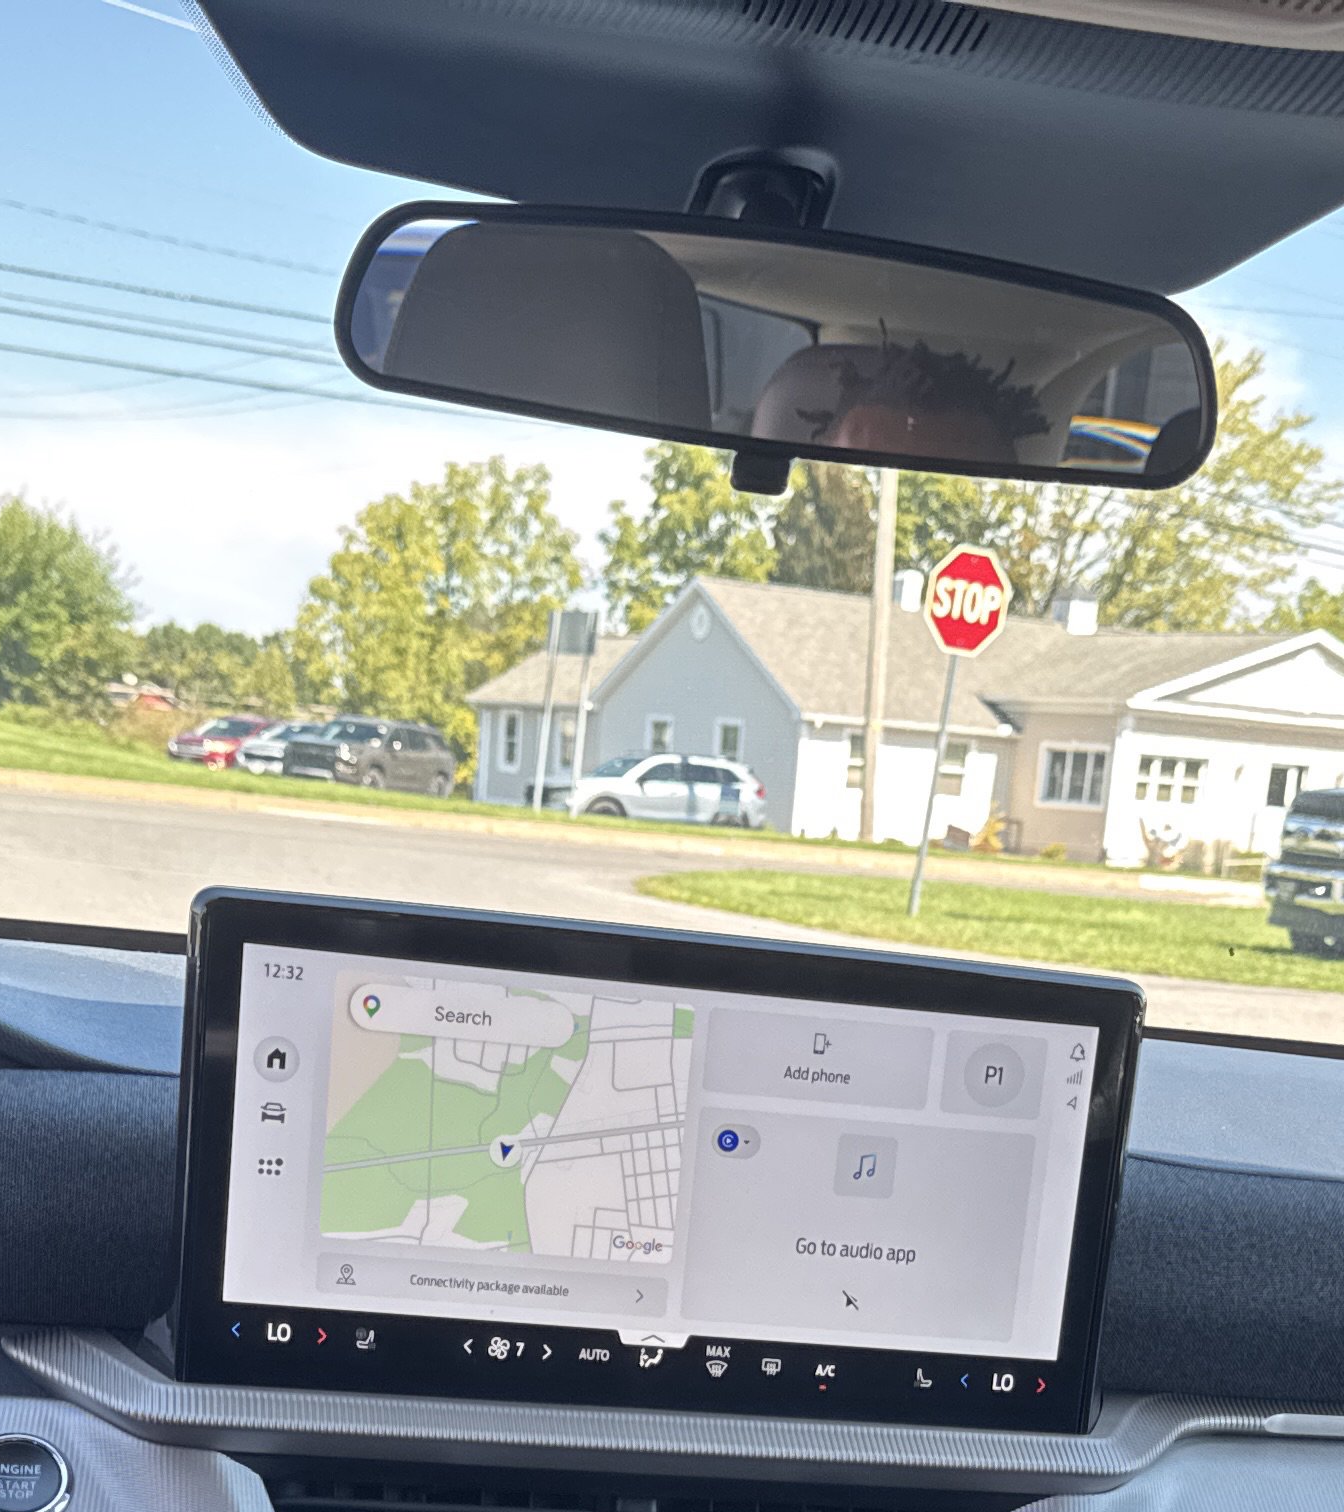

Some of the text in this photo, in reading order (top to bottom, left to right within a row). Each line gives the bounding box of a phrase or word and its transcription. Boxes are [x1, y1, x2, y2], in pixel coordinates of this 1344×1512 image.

[932, 576, 1002, 626] STOP
[264, 963, 304, 981] 12:32
[434, 1005, 492, 1027] Search
[783, 1065, 851, 1085] Add phone
[984, 1064, 1004, 1086] P1
[612, 1234, 663, 1254] Google
[795, 1237, 916, 1265] Go to audio app
[409, 1273, 570, 1297] Connectivity package available
[267, 1322, 291, 1343] LO
[515, 1341, 525, 1357] 7
[578, 1347, 610, 1362] AUTO
[705, 1345, 732, 1359] MAX
[814, 1363, 836, 1378] A/C
[991, 1373, 1014, 1392] LO
[0, 1489, 34, 1499] STOP
